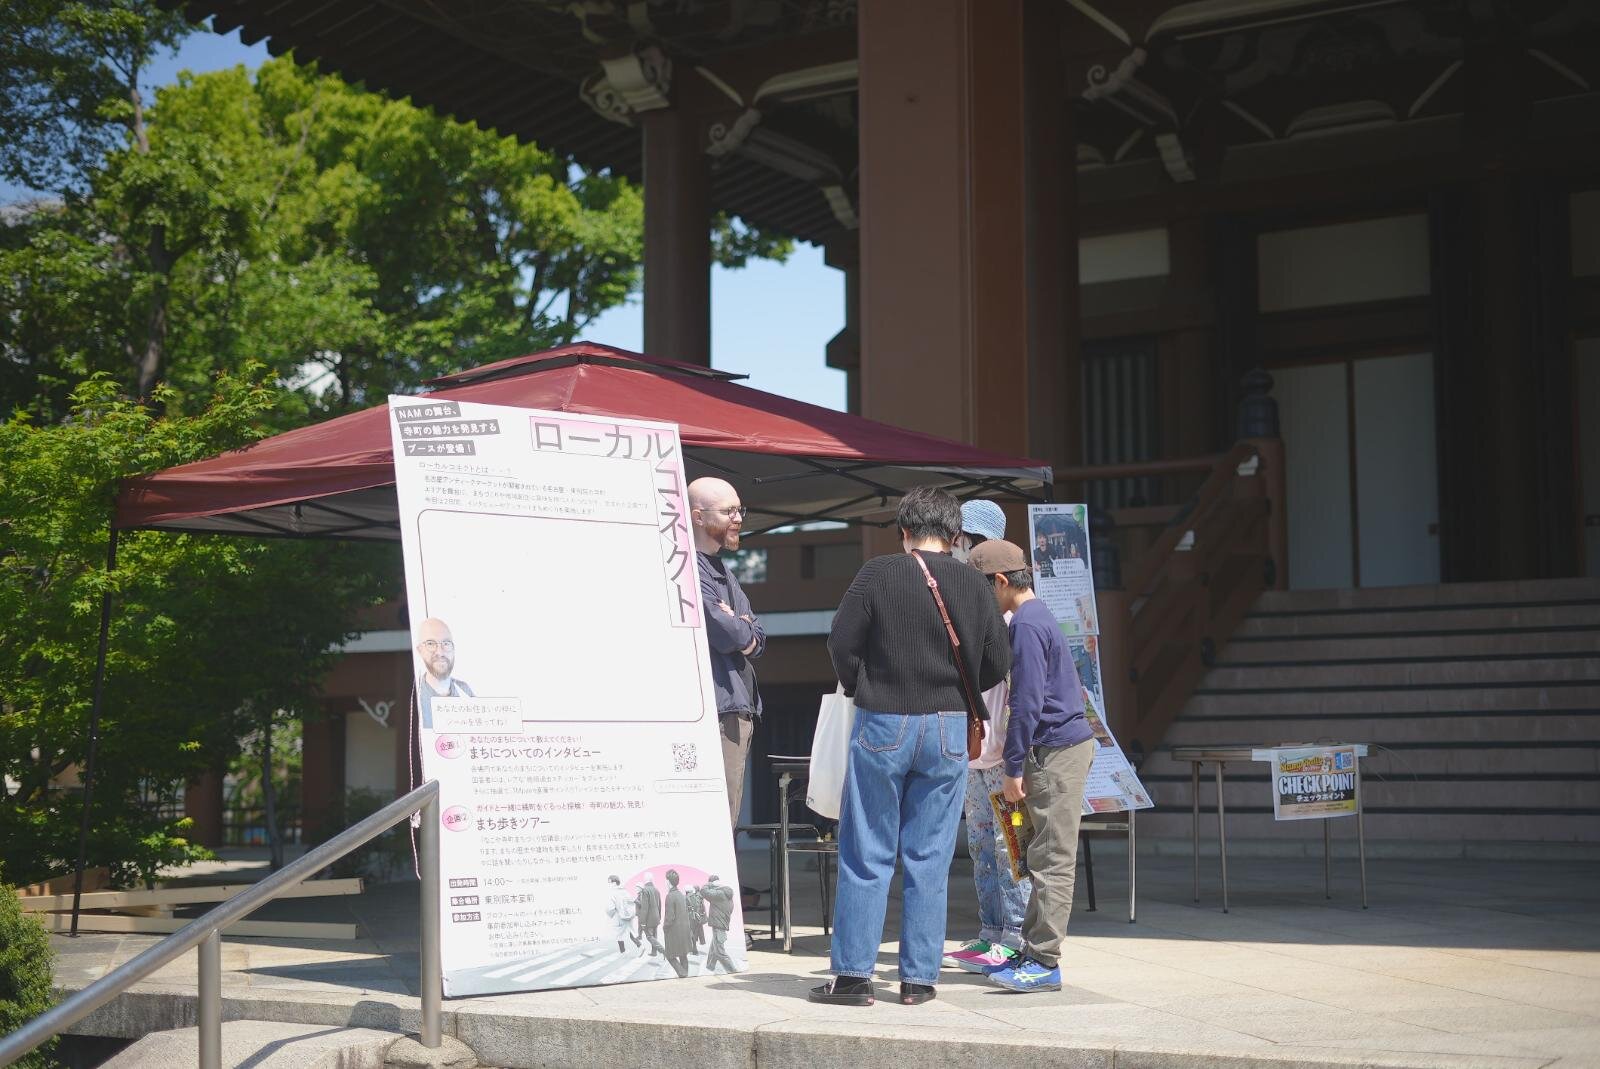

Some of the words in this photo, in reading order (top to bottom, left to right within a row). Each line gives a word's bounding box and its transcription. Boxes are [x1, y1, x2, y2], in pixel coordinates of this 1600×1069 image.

[399, 409, 422, 419] NAM
[403, 422, 497, 437] 寺町の魅力を発見する
[534, 422, 674, 461] ローカル
[656, 468, 695, 623] コネクト
[470, 746, 601, 760] まちについてのインタビュー
[1279, 776, 1320, 795] CHECK
[1321, 773, 1355, 793] POINT
[1296, 791, 1345, 802] チェックポイント
[476, 816, 551, 831] まち歩きツアー
